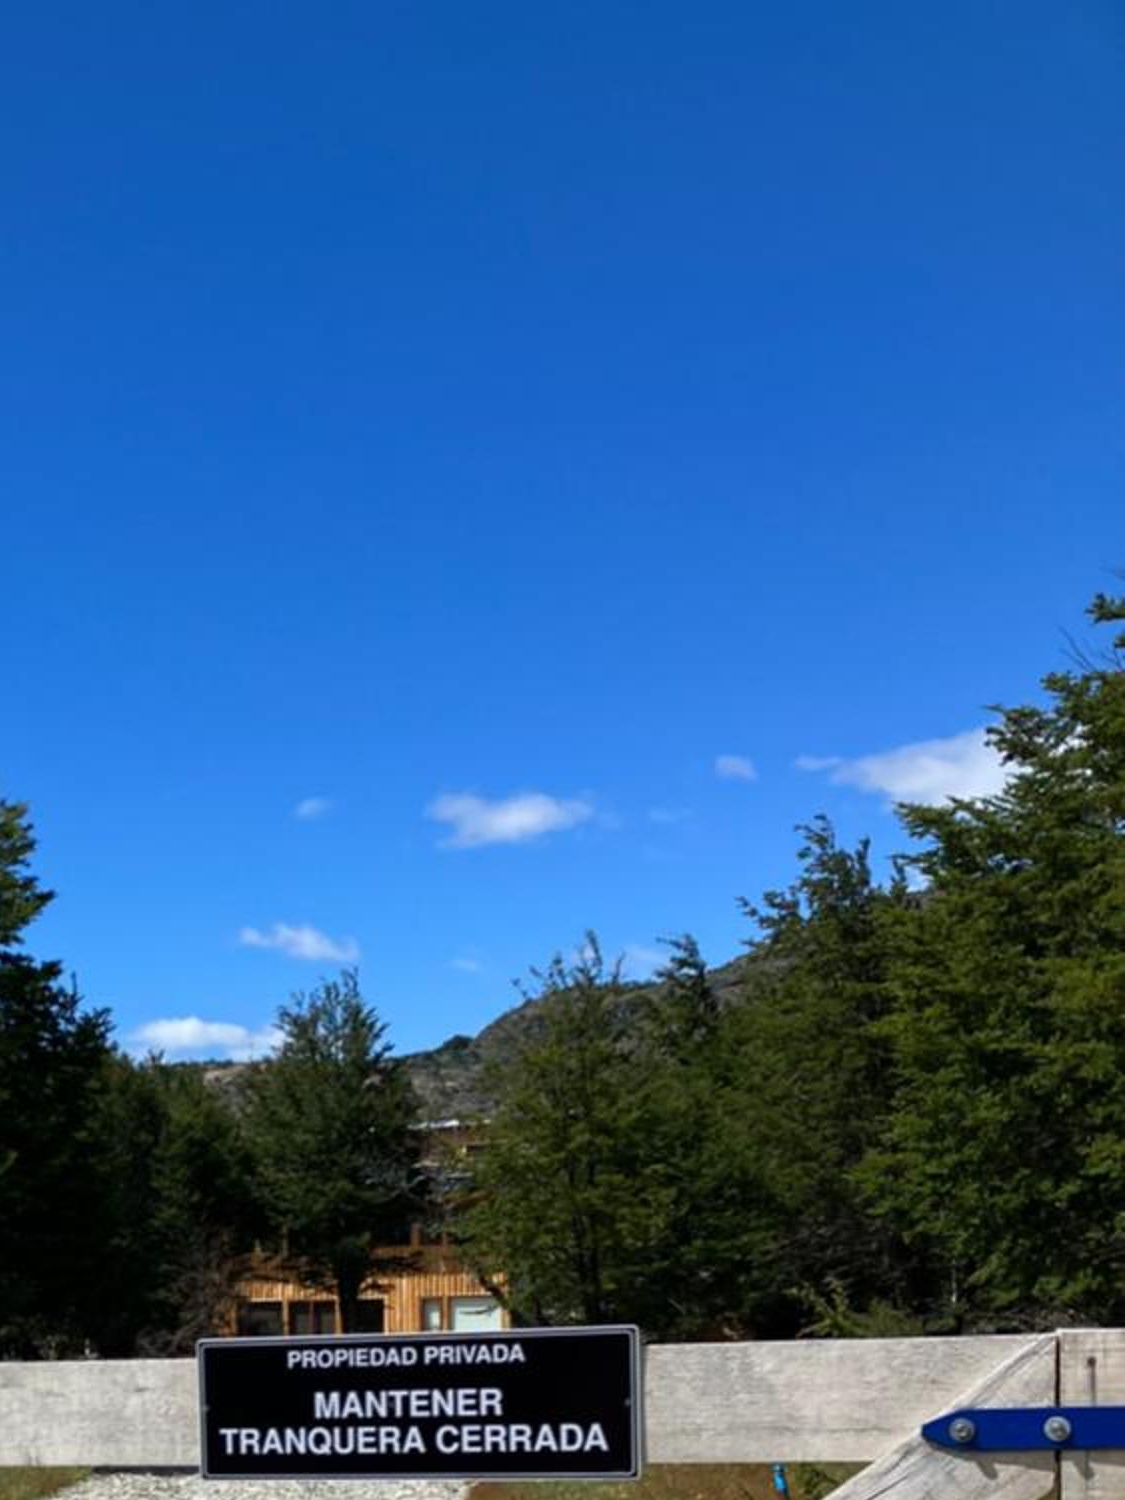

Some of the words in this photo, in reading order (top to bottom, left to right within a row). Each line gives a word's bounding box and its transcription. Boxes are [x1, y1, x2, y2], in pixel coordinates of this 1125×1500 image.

[288, 1347, 417, 1368] PROPIEDAD
[425, 1344, 525, 1364] PRIVADA
[315, 1388, 502, 1418] MANTENER
[220, 1426, 425, 1454] TRANQUERA
[436, 1423, 608, 1453] CERRADA
